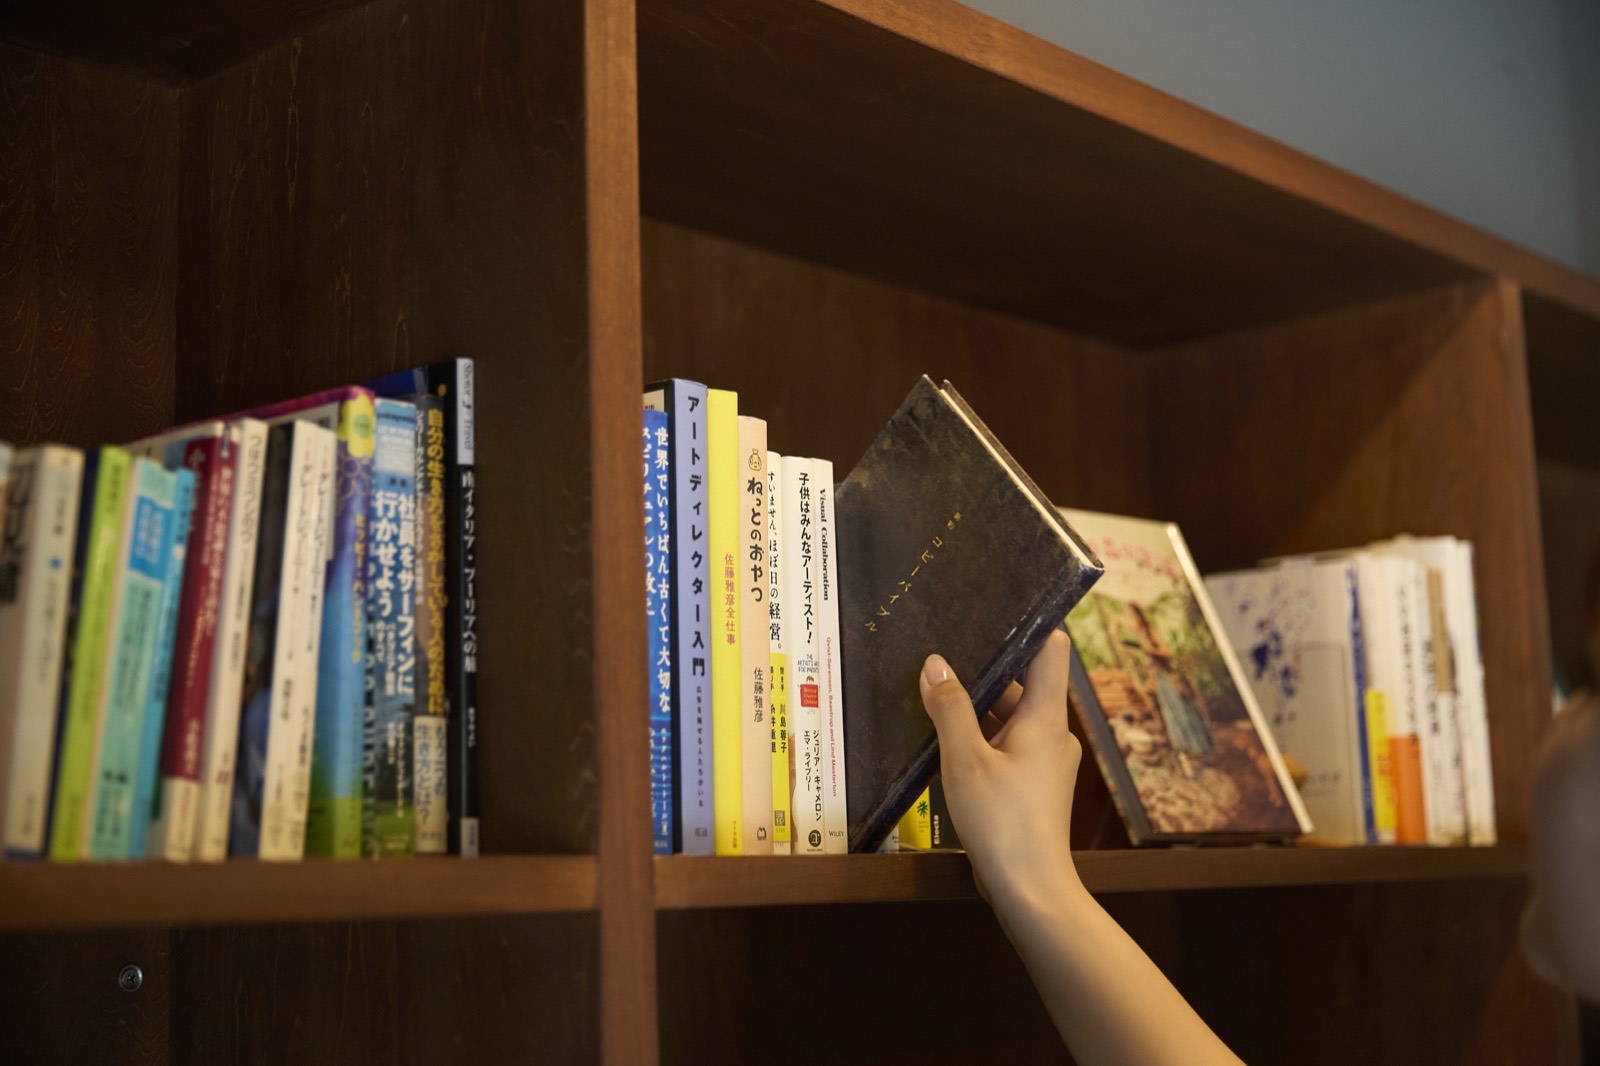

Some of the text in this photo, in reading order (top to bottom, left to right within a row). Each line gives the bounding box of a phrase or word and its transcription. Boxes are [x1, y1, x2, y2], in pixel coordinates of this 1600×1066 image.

[375, 489, 398, 617] 行かせよう
[397, 491, 415, 694] 社員をサーフィンに
[655, 426, 671, 713] 世界でいちばん古くて大切な
[687, 396, 705, 676] アートディレクター入門
[724, 553, 736, 645] 佐藤雅彦全仕事
[747, 476, 764, 602] ねっとのおやつ
[768, 470, 781, 649] すいません、ほぼ日の経営。
[798, 472, 814, 644] 子供はみんなアーティスト!
[819, 488, 829, 601] Visual Collaboration
[753, 667, 764, 722] 佐藤雅彦
[779, 703, 787, 753] 川島蓉子
[813, 729, 822, 821] ジュリア・キャメロン
